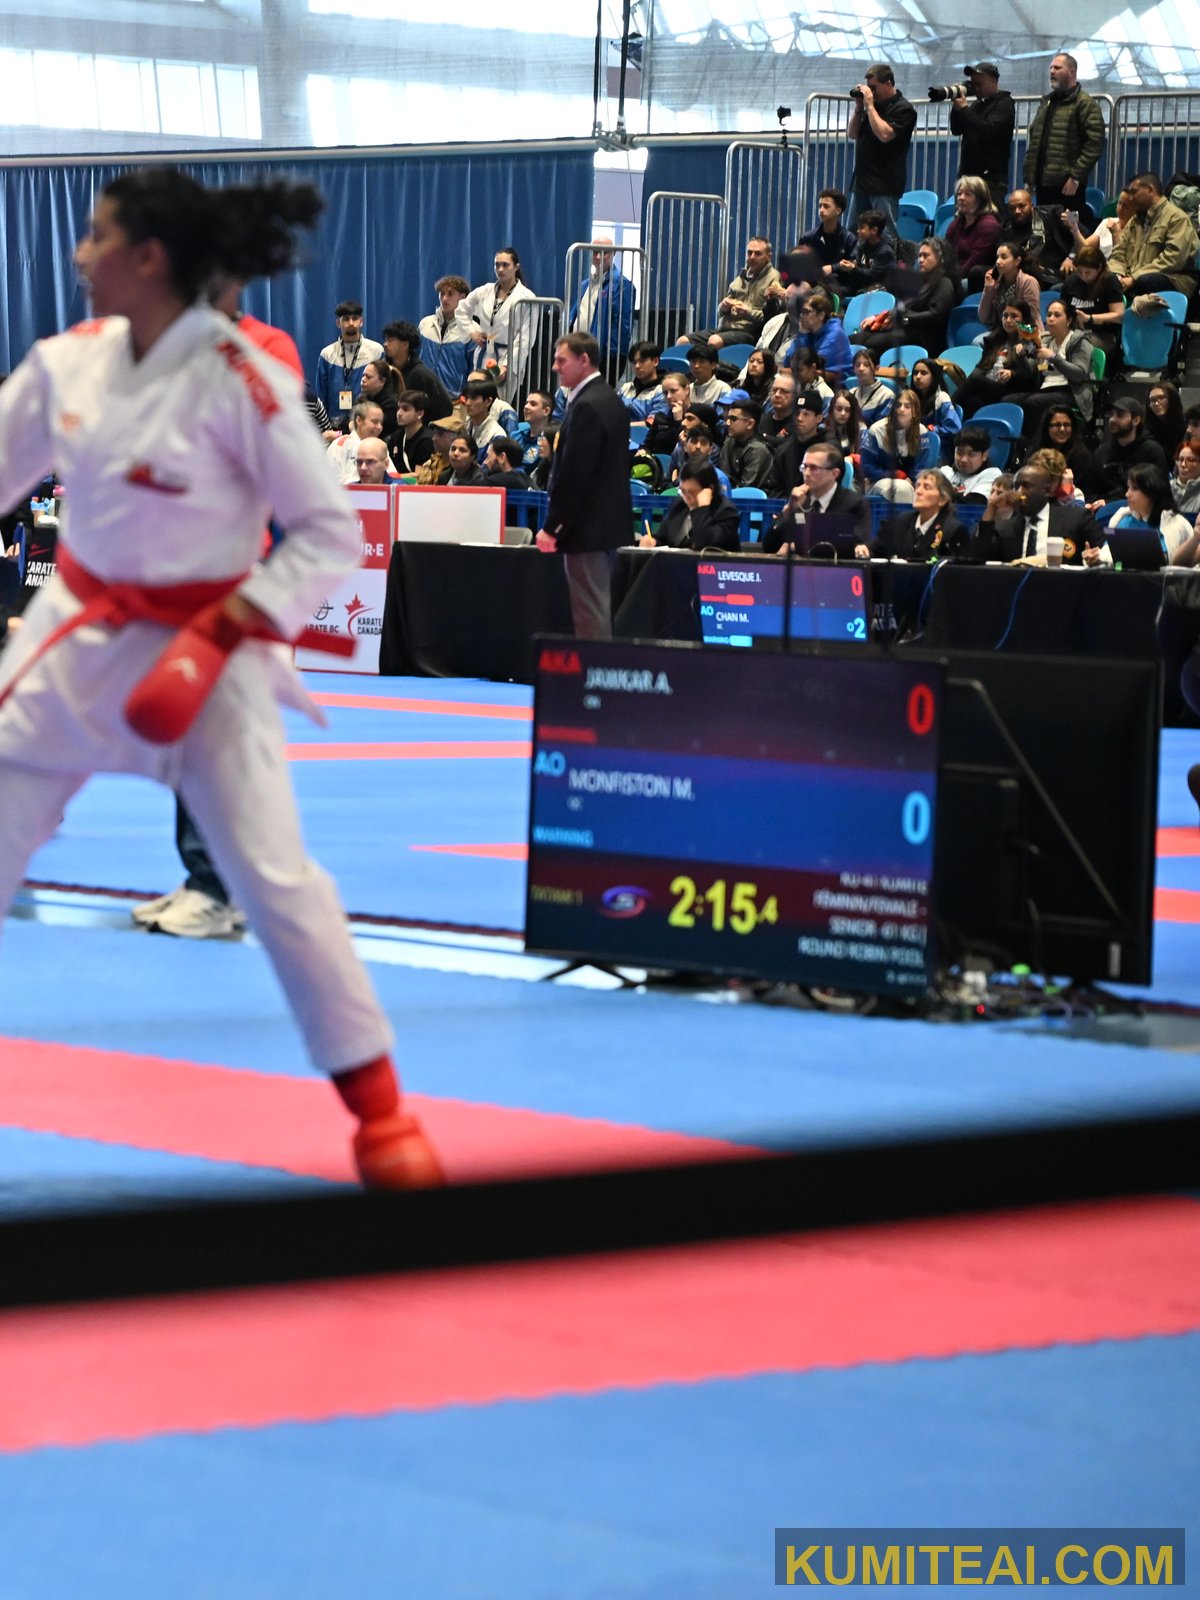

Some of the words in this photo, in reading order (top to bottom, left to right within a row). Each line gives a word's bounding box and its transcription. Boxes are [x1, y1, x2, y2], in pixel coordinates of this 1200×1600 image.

[718, 571, 755, 582] LEVESQUE
[851, 575, 863, 597] 0
[357, 617, 382, 627] KARATE
[701, 605, 714, 616] AO
[716, 611, 738, 622] CHAN
[304, 624, 328, 633] ARATE
[539, 651, 582, 673] AKA
[908, 683, 935, 735] 0
[534, 752, 566, 777] AO
[902, 792, 930, 845] 0
